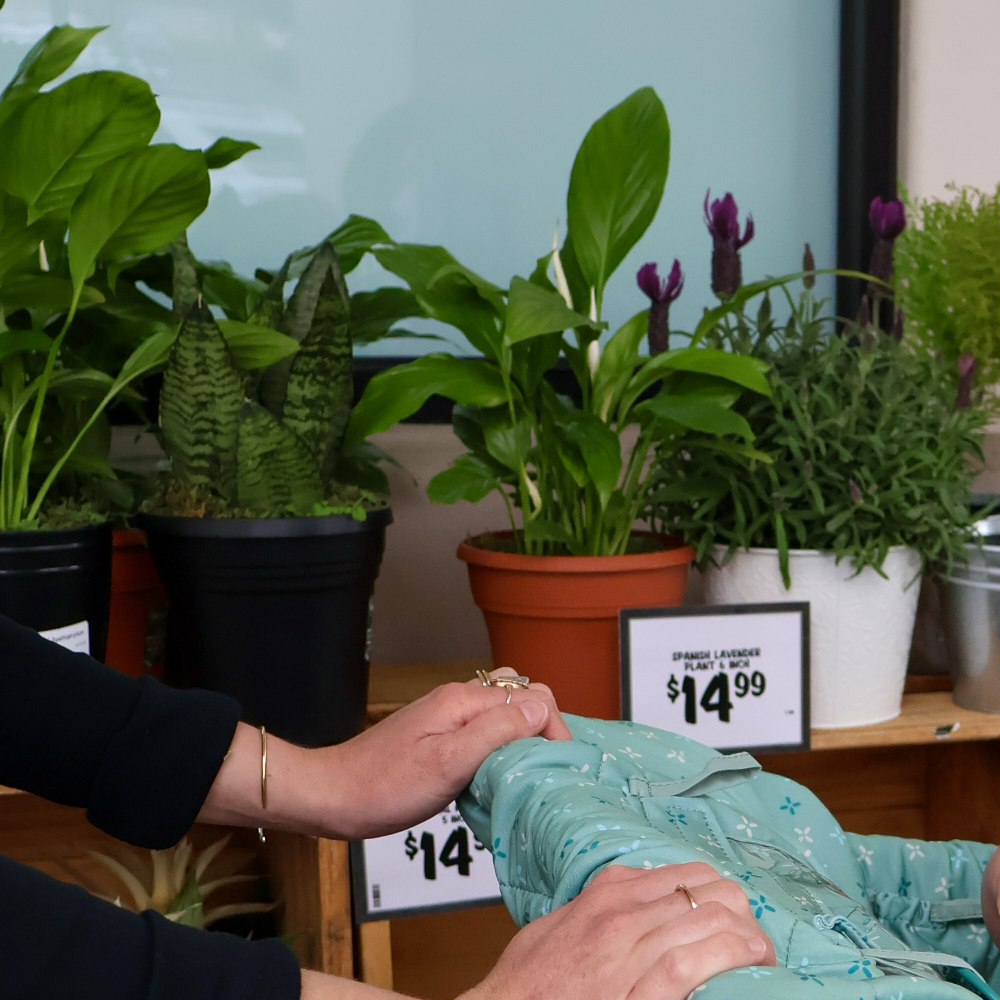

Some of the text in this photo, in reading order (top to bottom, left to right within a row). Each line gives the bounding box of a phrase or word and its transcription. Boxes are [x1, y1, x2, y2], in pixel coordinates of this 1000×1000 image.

[672, 647, 761, 661] SPANISH LAVENDER
[684, 660, 714, 671] PLANT
[729, 658, 750, 669] INCH
